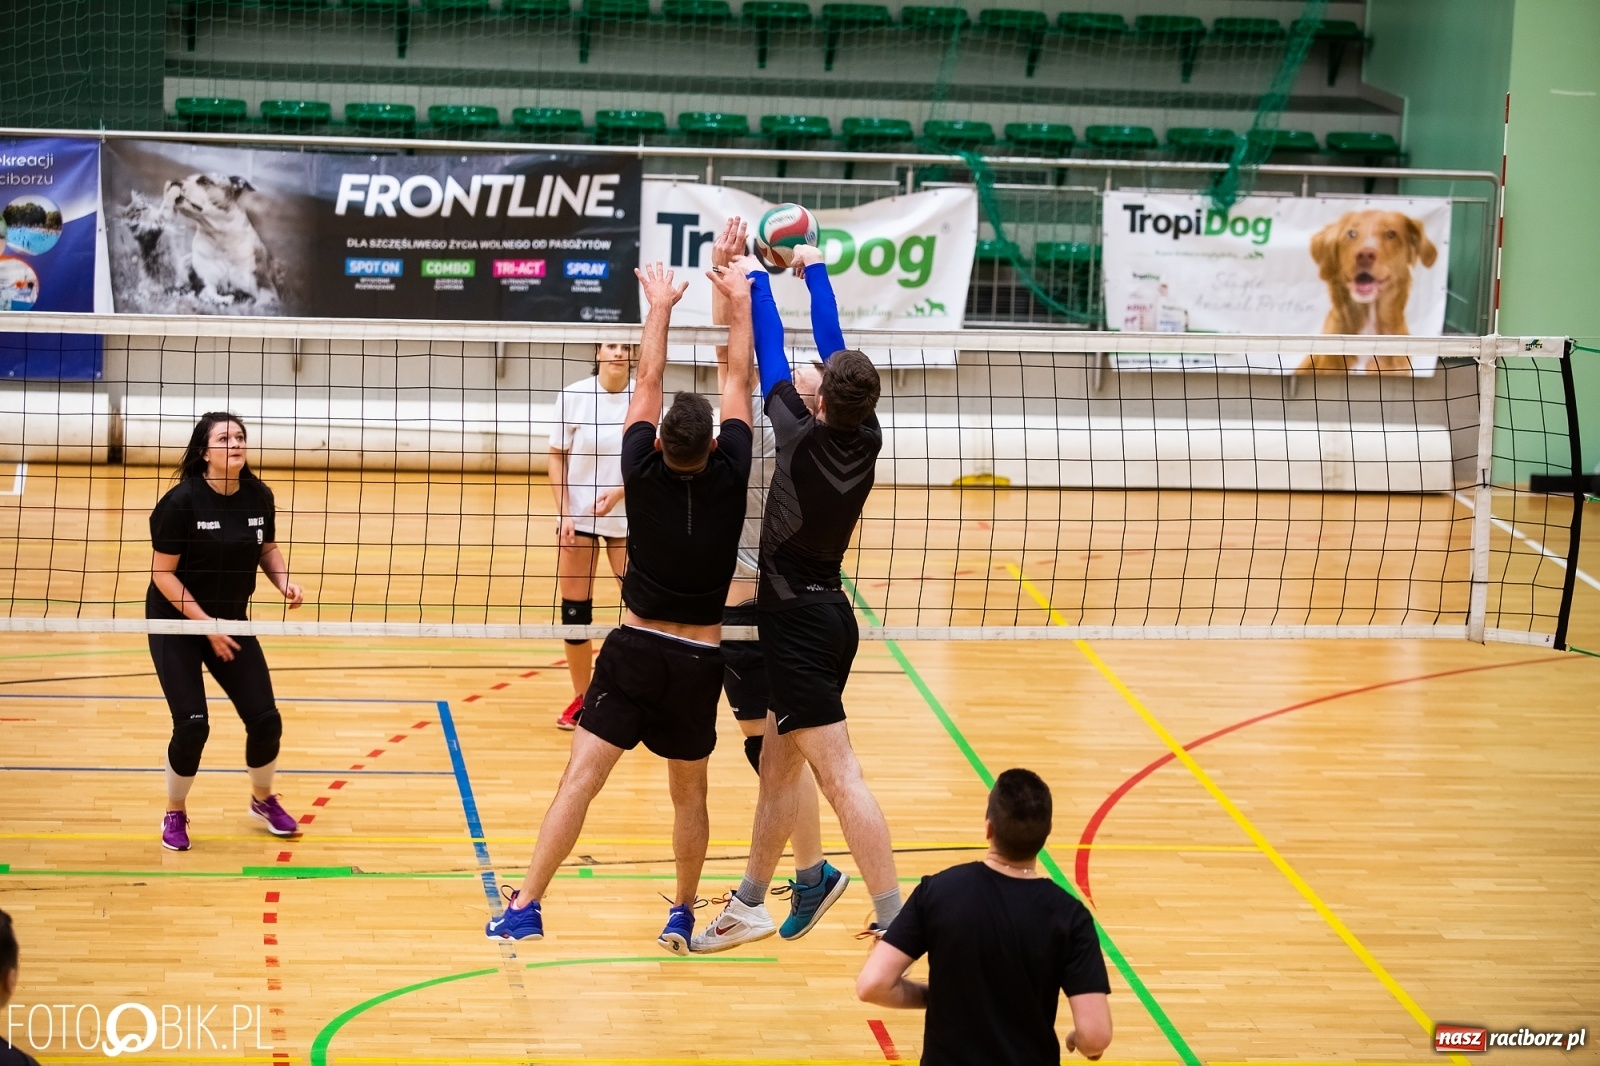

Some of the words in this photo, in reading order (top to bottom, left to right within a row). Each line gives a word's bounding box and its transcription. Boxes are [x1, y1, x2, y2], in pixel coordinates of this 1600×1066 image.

[0, 152, 54, 169] kreacji
[1123, 204, 1272, 245] TropiDog
[347, 238, 368, 248] DLA
[369, 238, 447, 251] SZCZĘŚLIWEGO
[448, 239, 478, 250] ŻYCIA
[480, 239, 529, 250] WOLNEGO
[532, 239, 547, 250] OD
[549, 238, 611, 251] PASOŻYTÓW
[656, 212, 937, 288] TrDog
[349, 260, 379, 273] SPOT
[381, 261, 400, 274] ON
[426, 261, 470, 275] COMBO
[496, 261, 542, 275] TRI-ACT
[567, 262, 606, 276] SPRAY
